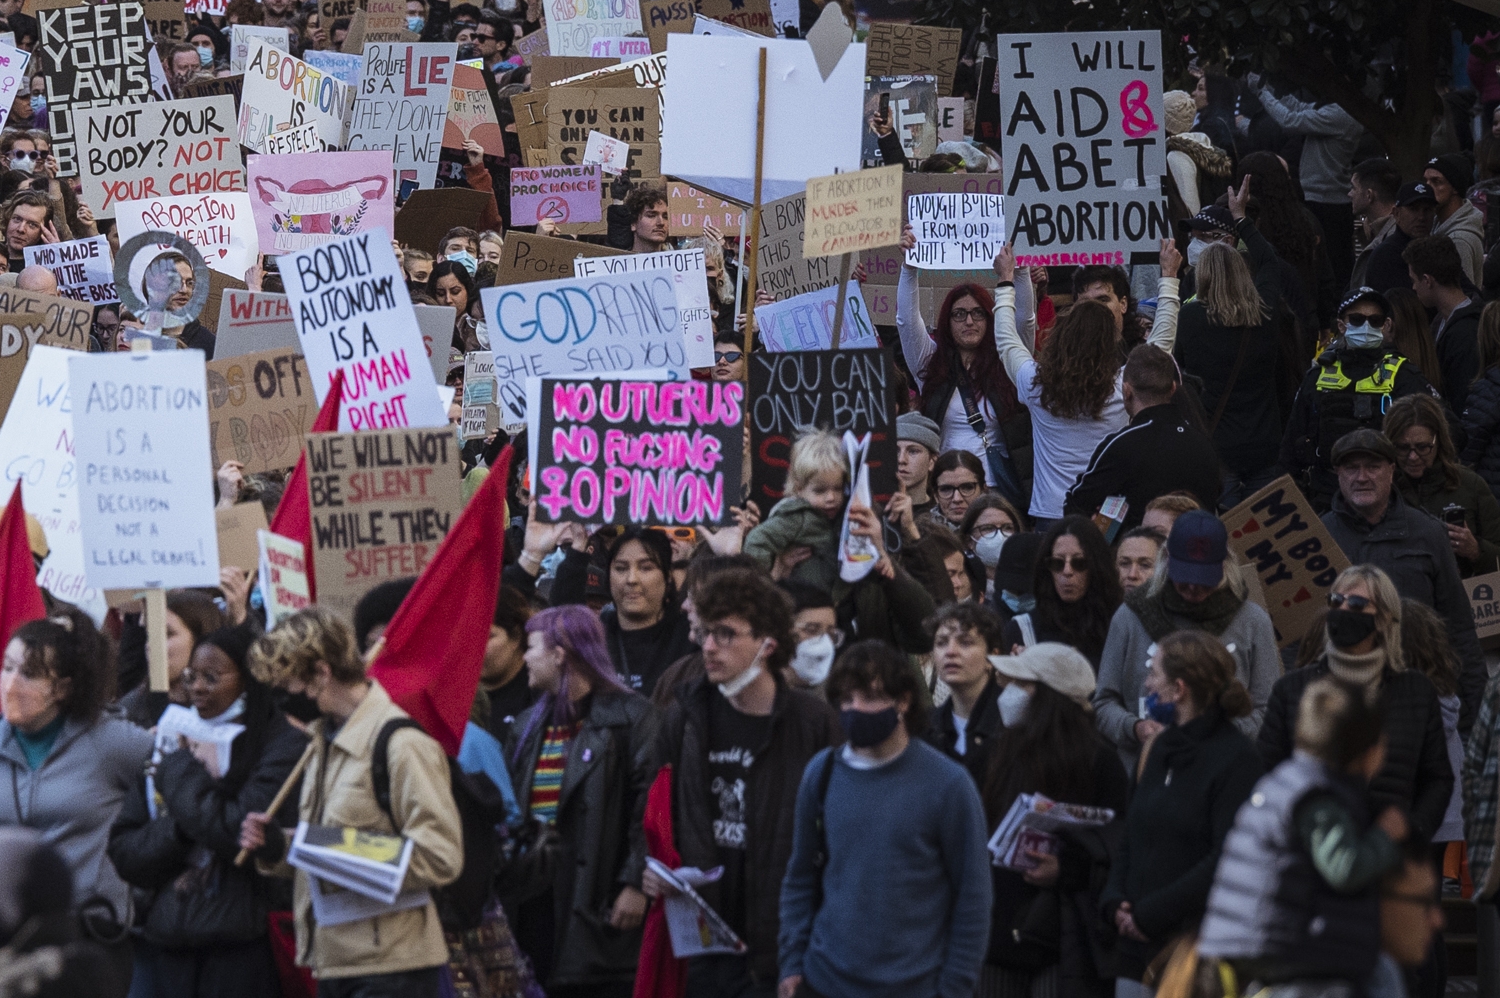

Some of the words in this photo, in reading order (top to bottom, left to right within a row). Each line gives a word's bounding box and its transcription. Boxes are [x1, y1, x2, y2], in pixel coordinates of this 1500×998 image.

[39, 3, 144, 44] KEEP
[44, 36, 146, 72] YOUR
[404, 46, 450, 98] LIE
[1011, 42, 1034, 78] I
[1071, 40, 1155, 73] WILL
[47, 67, 149, 102] LAWS
[88, 110, 142, 143] NOT
[161, 105, 224, 137] YOUR
[561, 109, 598, 126] YOU
[608, 107, 645, 123] CAN
[1006, 88, 1109, 137] AID
[1119, 80, 1158, 138] &
[173, 137, 231, 168] NOT
[1007, 137, 1157, 197] ABET
[101, 176, 160, 211] YOUR
[169, 169, 242, 196] CHOICE
[909, 195, 956, 219] ENOUGH
[922, 221, 957, 239] FROM
[964, 220, 989, 238] OLD
[1011, 201, 1171, 247] ABORTION
[60, 240, 99, 263] MADE
[296, 233, 370, 294] BODILY
[299, 275, 397, 334] AUTONOMY
[496, 286, 597, 345] GOD
[495, 354, 549, 379] SHE
[754, 354, 822, 393] YOU
[830, 353, 887, 390] CAN
[85, 381, 203, 414] ABORTION
[552, 381, 595, 423] NO
[753, 393, 824, 433] ONLY
[832, 394, 888, 431] BAN
[307, 435, 348, 473] WE
[352, 433, 402, 466] WILL
[404, 431, 452, 464] NOT
[552, 427, 599, 464] NO
[310, 475, 342, 507] BE
[348, 469, 434, 502] SILENT
[313, 509, 386, 550] WHILE
